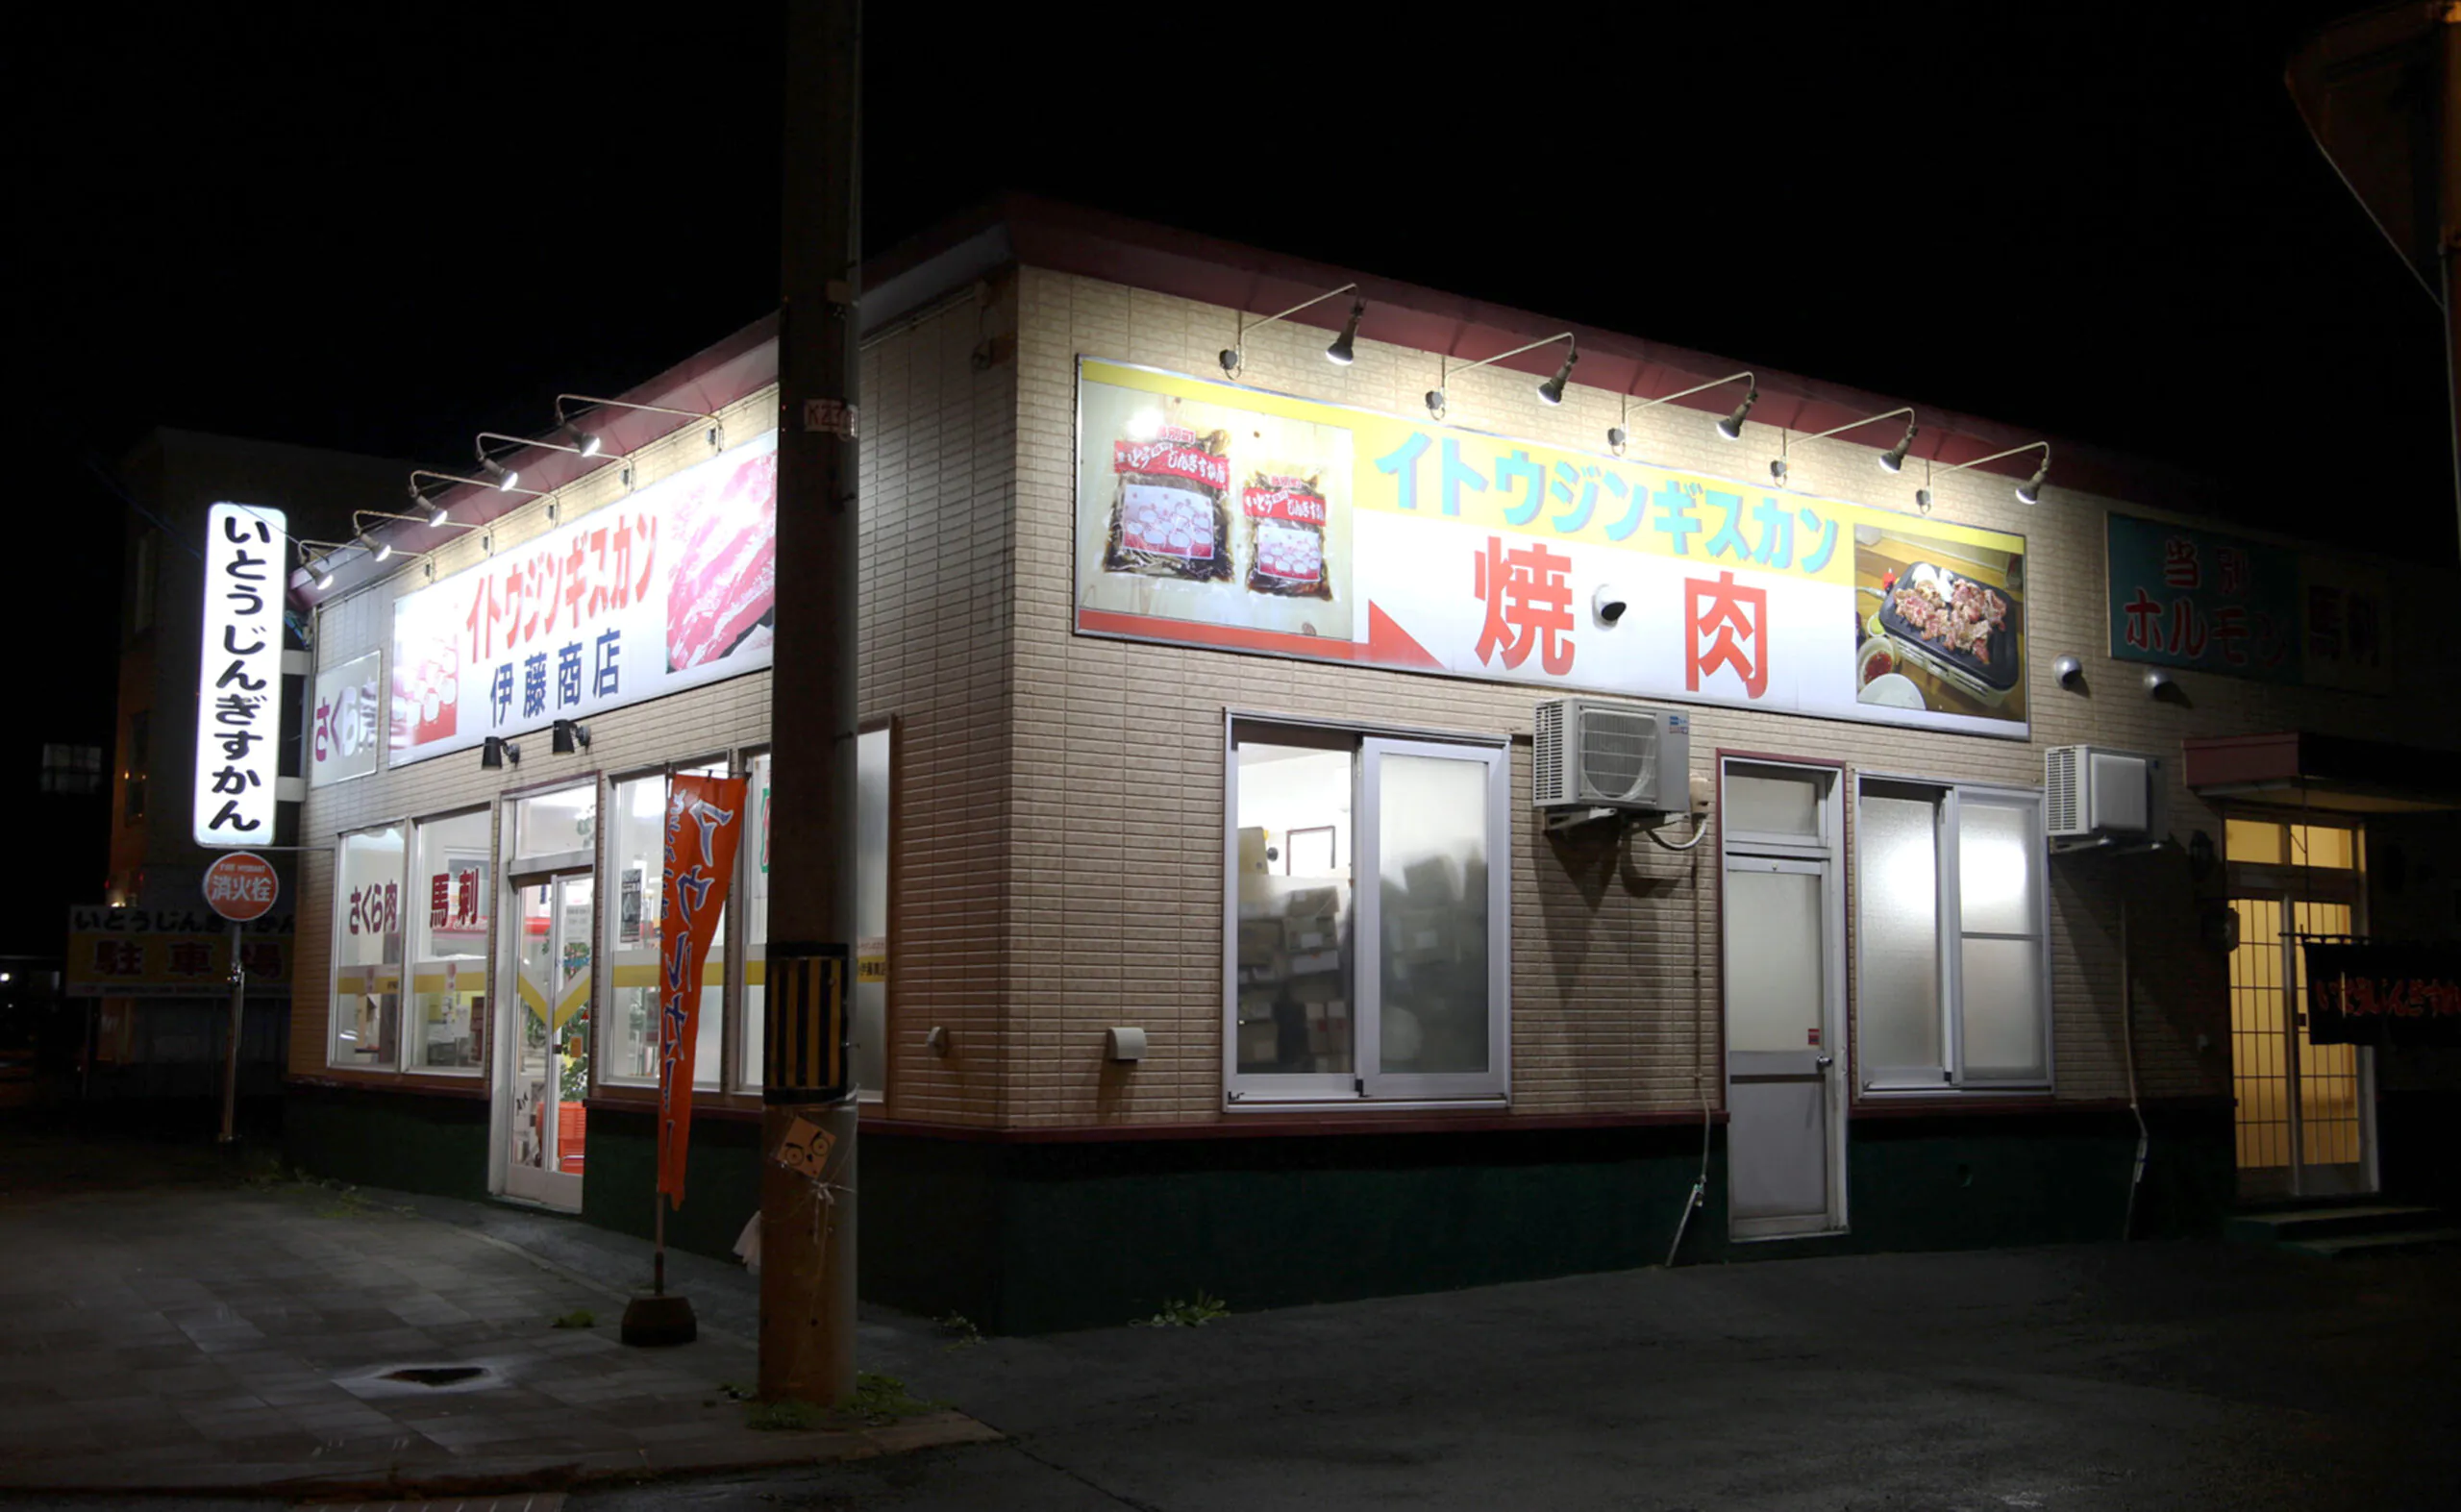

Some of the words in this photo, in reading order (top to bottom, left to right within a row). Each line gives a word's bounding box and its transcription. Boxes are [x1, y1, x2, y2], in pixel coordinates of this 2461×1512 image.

[1374, 431, 1839, 574] イトウジンギスカン
[465, 512, 658, 664] イトウジンギスカン
[1474, 535, 1769, 700] 焼肉
[209, 516, 271, 831] いとうじんぎすかん
[489, 628, 621, 729] 伊藤商店
[211, 875, 272, 903] 消火栓
[349, 879, 398, 935] さくら肉
[430, 868, 480, 929] 馬刺
